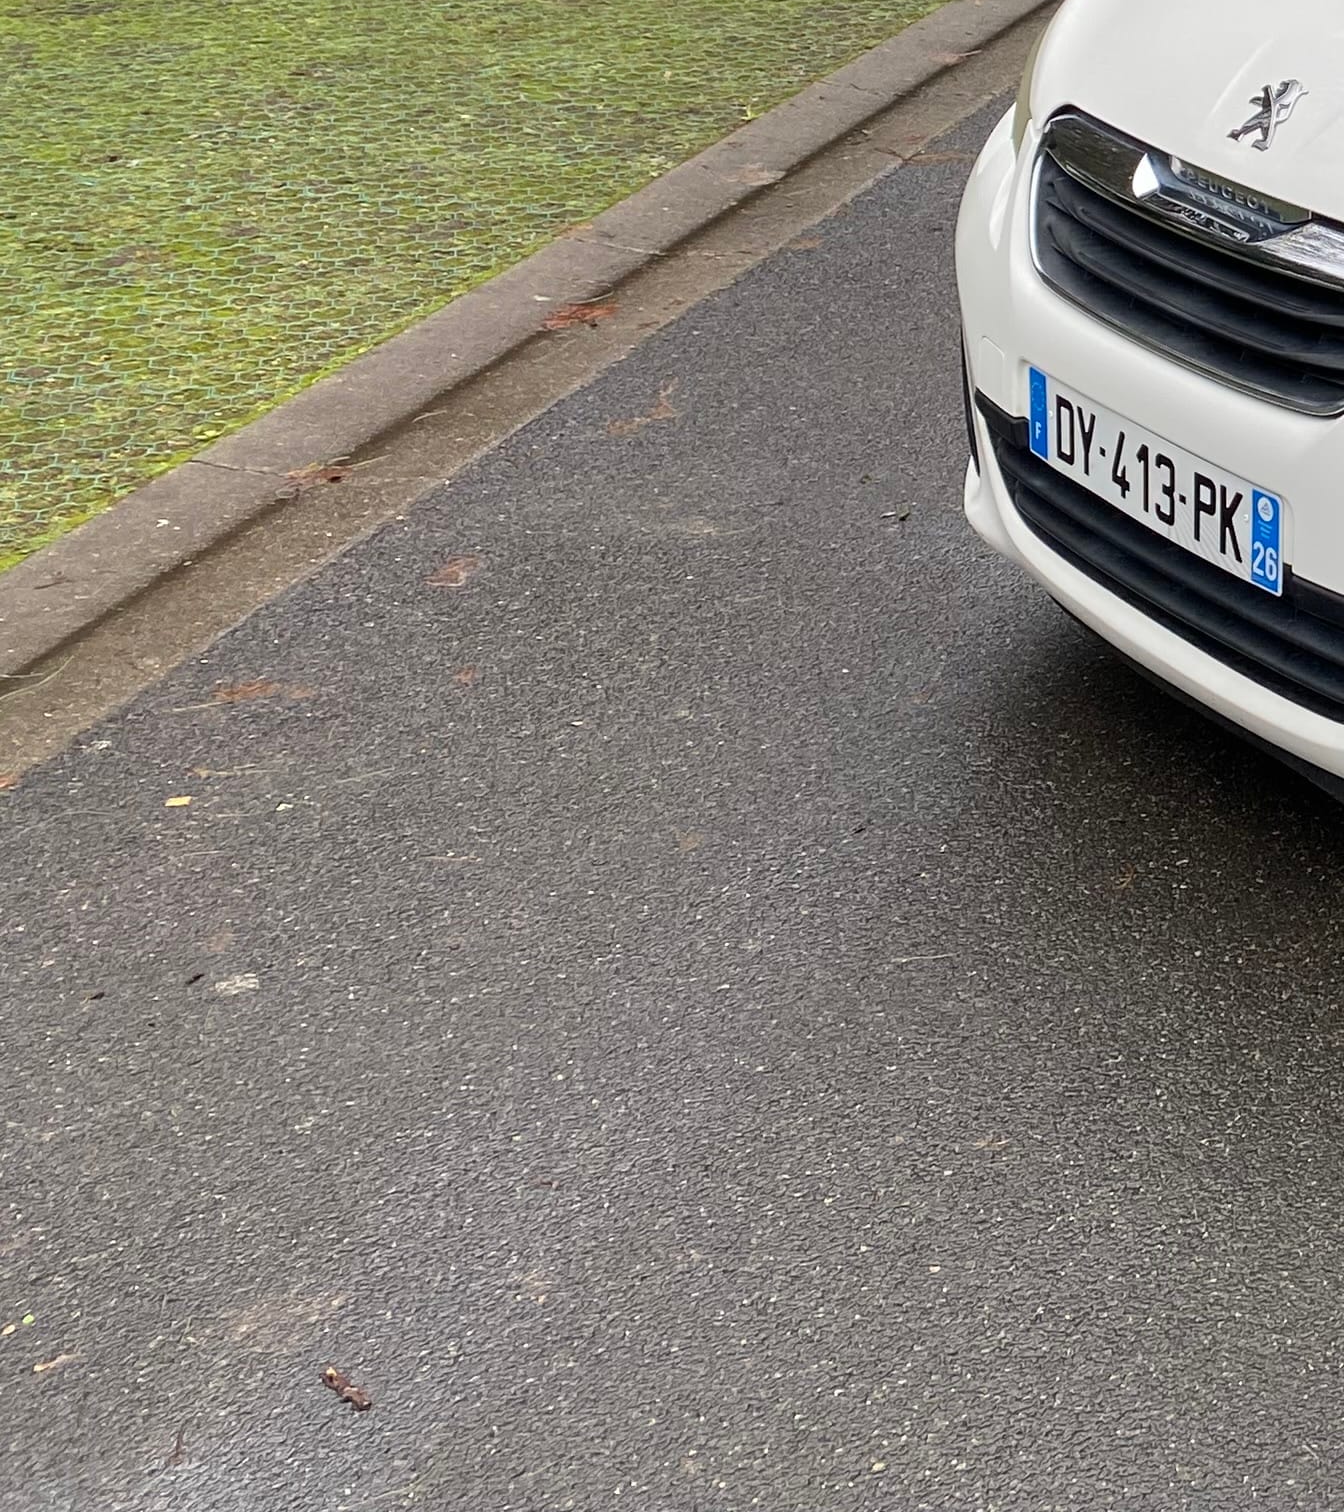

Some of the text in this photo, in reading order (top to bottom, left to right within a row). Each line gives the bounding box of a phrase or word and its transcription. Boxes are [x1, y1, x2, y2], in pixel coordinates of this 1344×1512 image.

[1186, 168, 1270, 215] PEUGEOT
[1034, 421, 1042, 439] F
[1055, 394, 1244, 564] DY-413-PK
[1252, 541, 1278, 582] 26
